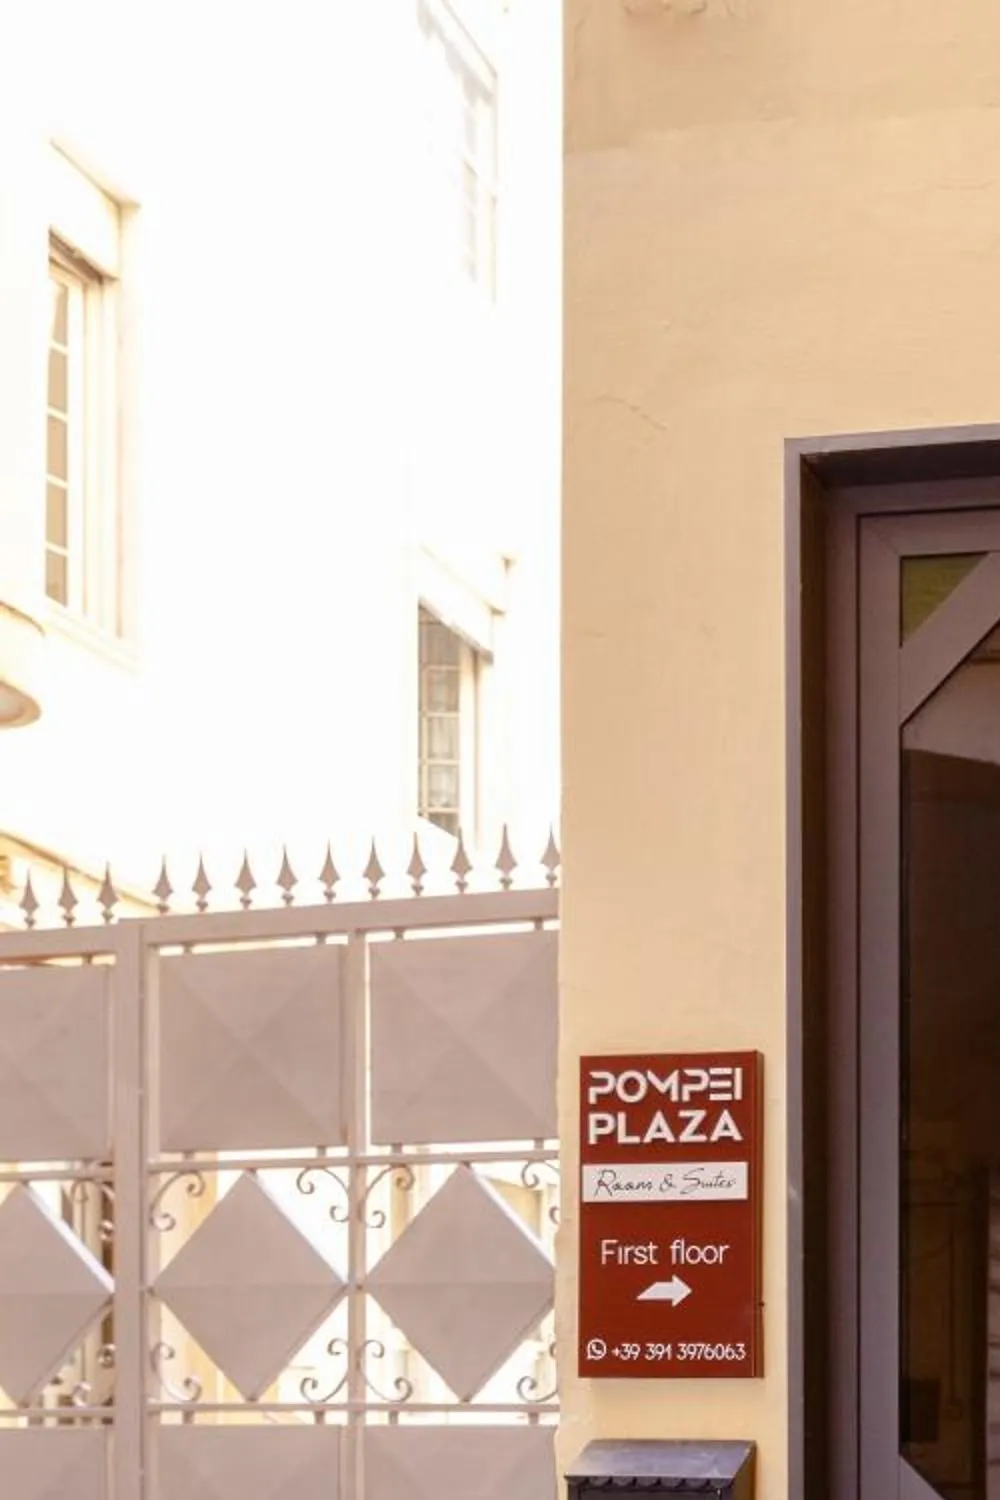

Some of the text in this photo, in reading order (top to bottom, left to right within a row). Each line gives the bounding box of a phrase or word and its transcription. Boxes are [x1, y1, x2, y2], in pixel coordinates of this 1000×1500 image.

[588, 1067, 743, 1104] POMPEI
[588, 1109, 743, 1145] PLAZA
[659, 1174, 677, 1193] &
[680, 1168, 737, 1194] Suites
[601, 1238, 730, 1265] First floor
[611, 1343, 746, 1361] +39 391 3976063
